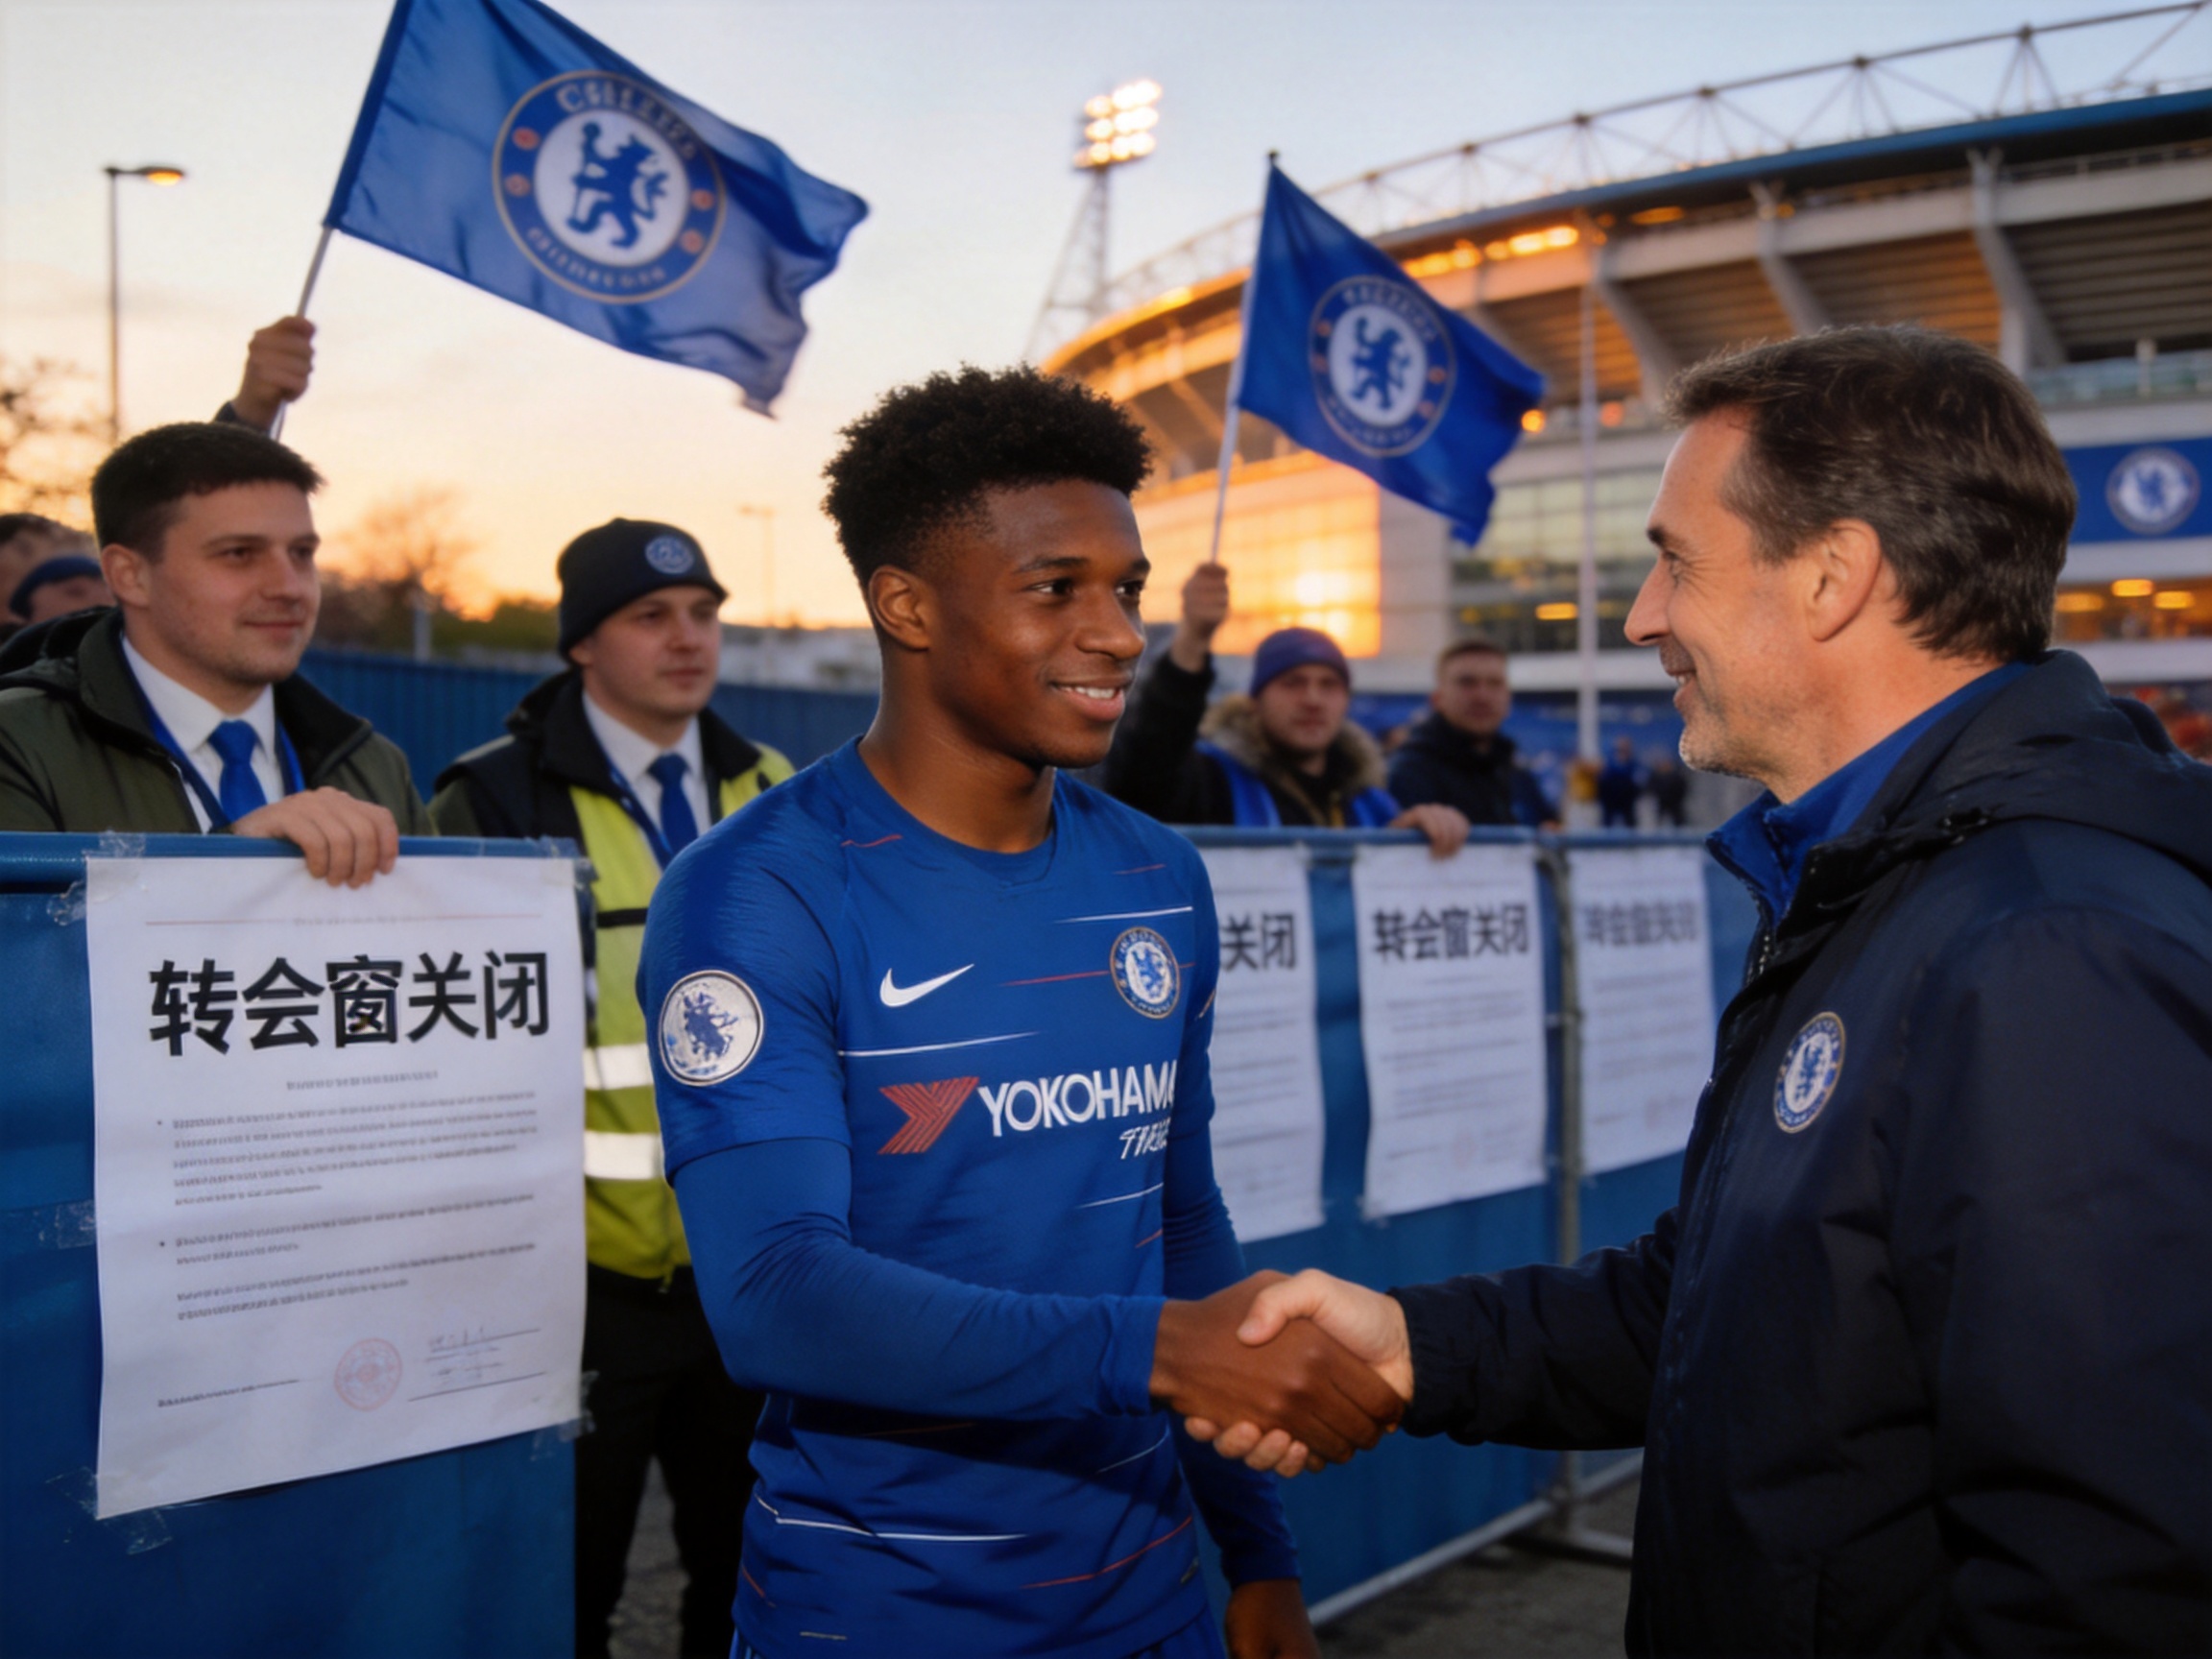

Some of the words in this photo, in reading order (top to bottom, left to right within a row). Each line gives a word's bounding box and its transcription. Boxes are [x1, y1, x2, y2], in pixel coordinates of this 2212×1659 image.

[1220, 913, 1295, 971] 关闭
[150, 950, 549, 1056] 转会窗关闭
